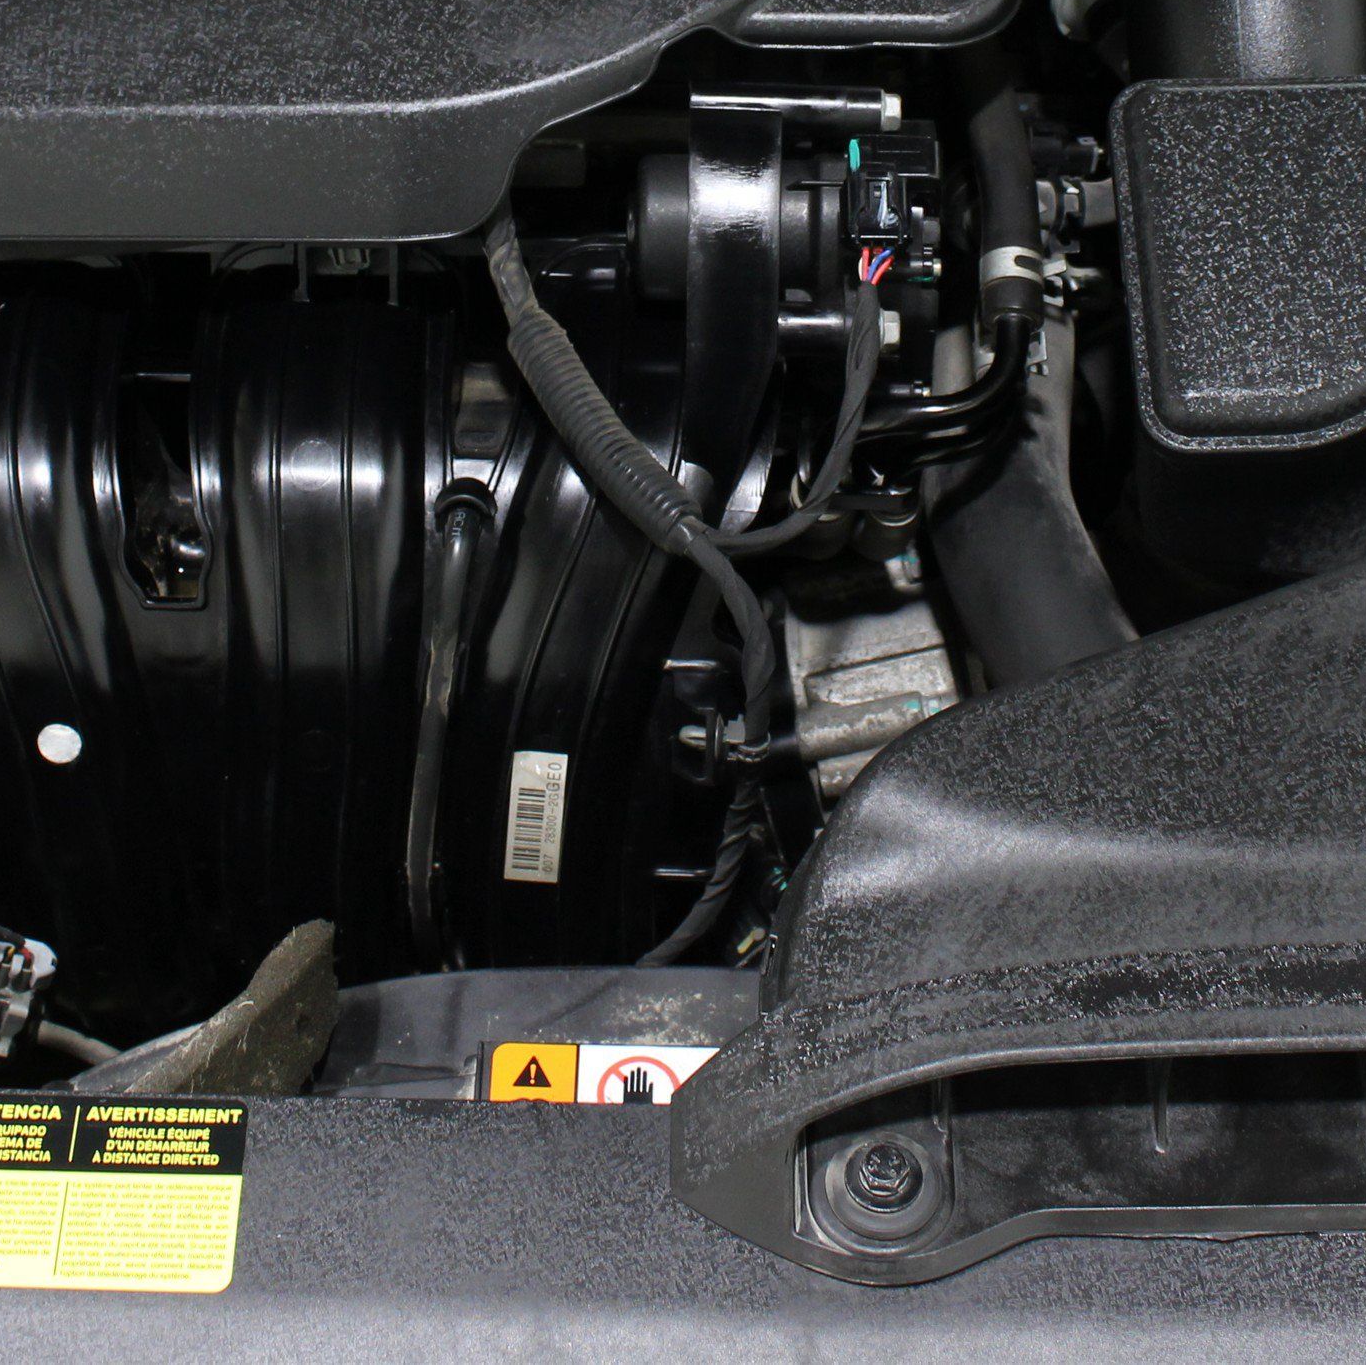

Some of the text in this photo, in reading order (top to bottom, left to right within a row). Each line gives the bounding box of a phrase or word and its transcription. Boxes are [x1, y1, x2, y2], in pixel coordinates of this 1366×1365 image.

[86, 1106, 243, 1124] AVERTISSEMENT
[109, 1125, 211, 1141] VÉHICULE ÉQUIPÉ
[26, 1137, 42, 1149] DE
[106, 1138, 210, 1153] D'UN DÉMARREUR
[103, 1151, 161, 1165] DISTANCE
[162, 1153, 220, 1166] DIRECTED
